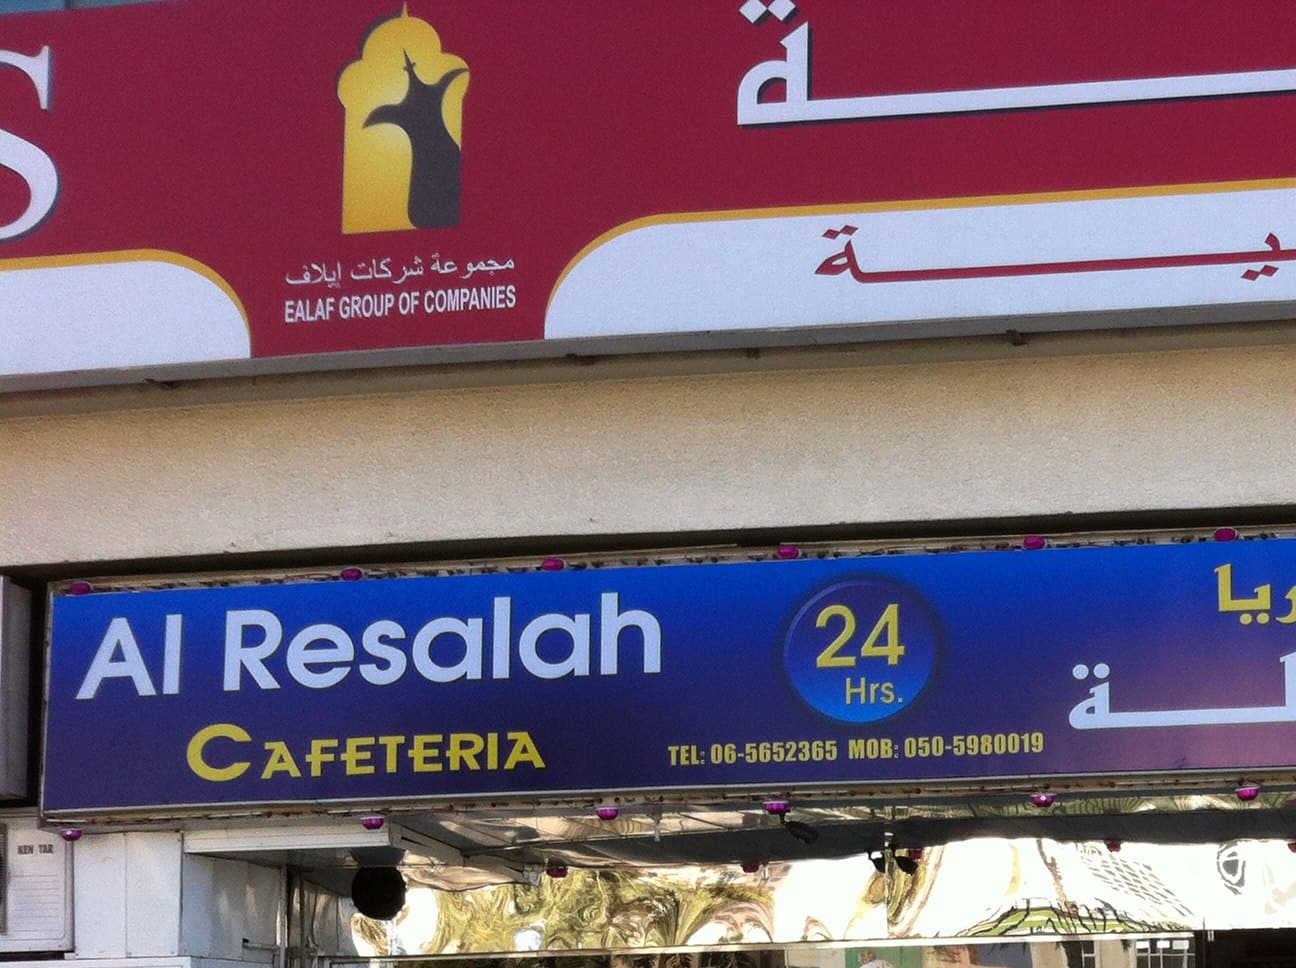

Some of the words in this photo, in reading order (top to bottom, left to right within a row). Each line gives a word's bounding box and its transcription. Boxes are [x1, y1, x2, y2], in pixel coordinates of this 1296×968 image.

[351, 255, 424, 284] شركات
[431, 252, 515, 279] مجموعة
[284, 298, 335, 324] EALAF
[339, 293, 394, 319] GROUP
[399, 291, 420, 315] OF
[424, 284, 517, 314] COMPANIES
[75, 613, 183, 700] Al
[222, 591, 663, 692] Resalah
[815, 603, 905, 668] 24
[844, 676, 904, 705] Hrs.
[668, 744, 705, 766] TEL:
[710, 740, 838, 764] 06-5652365
[848, 738, 899, 760] MOB:
[904, 732, 1044, 758] 050-5980019
